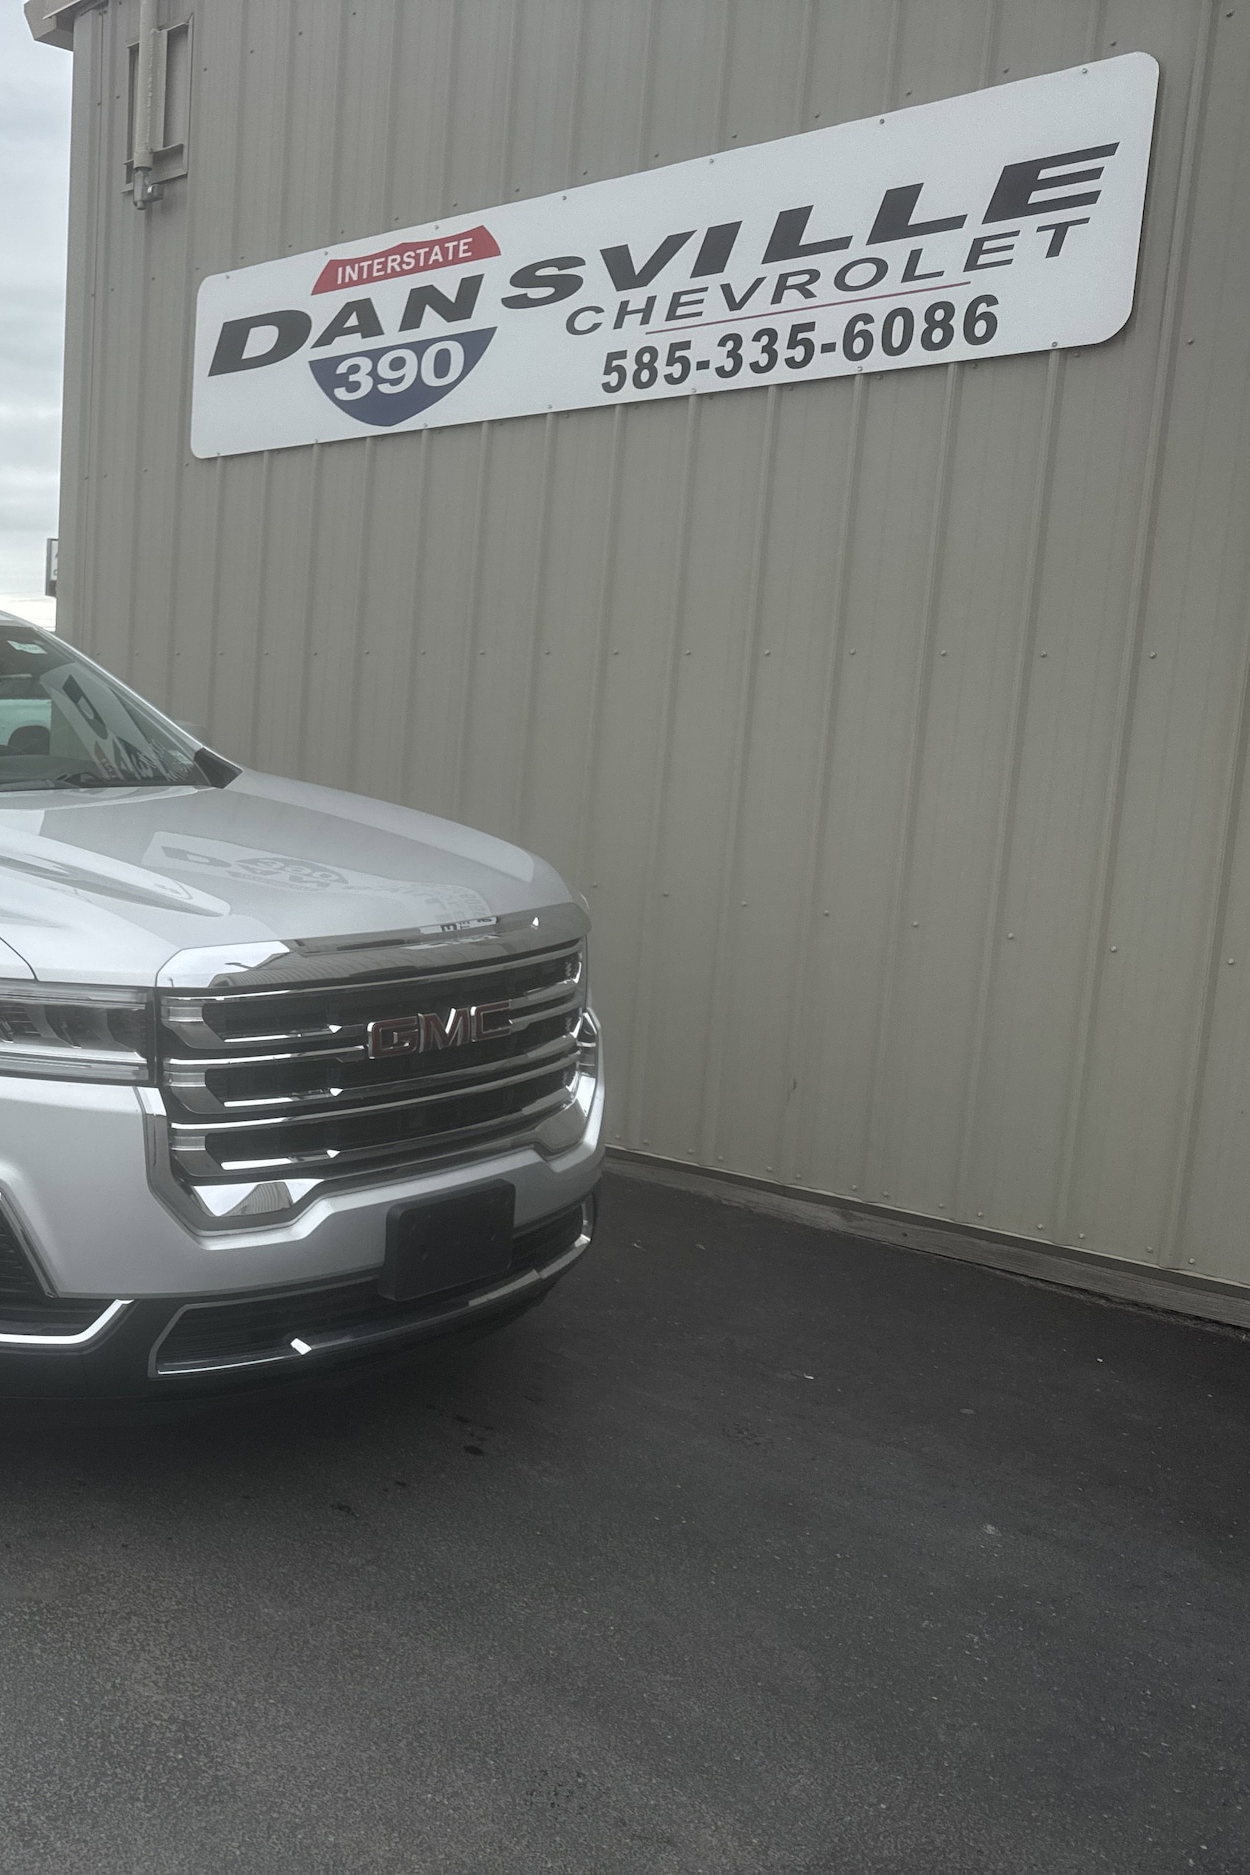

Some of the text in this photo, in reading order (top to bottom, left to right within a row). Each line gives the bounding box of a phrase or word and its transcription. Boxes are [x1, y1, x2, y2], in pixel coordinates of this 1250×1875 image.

[208, 141, 1120, 377] DANSVILLE
[336, 236, 472, 286] INTERSTATE
[565, 217, 1091, 336] CHEVROLET
[332, 339, 466, 401] 390
[600, 293, 999, 394] 585-335-6086
[366, 999, 512, 1060] GMC
